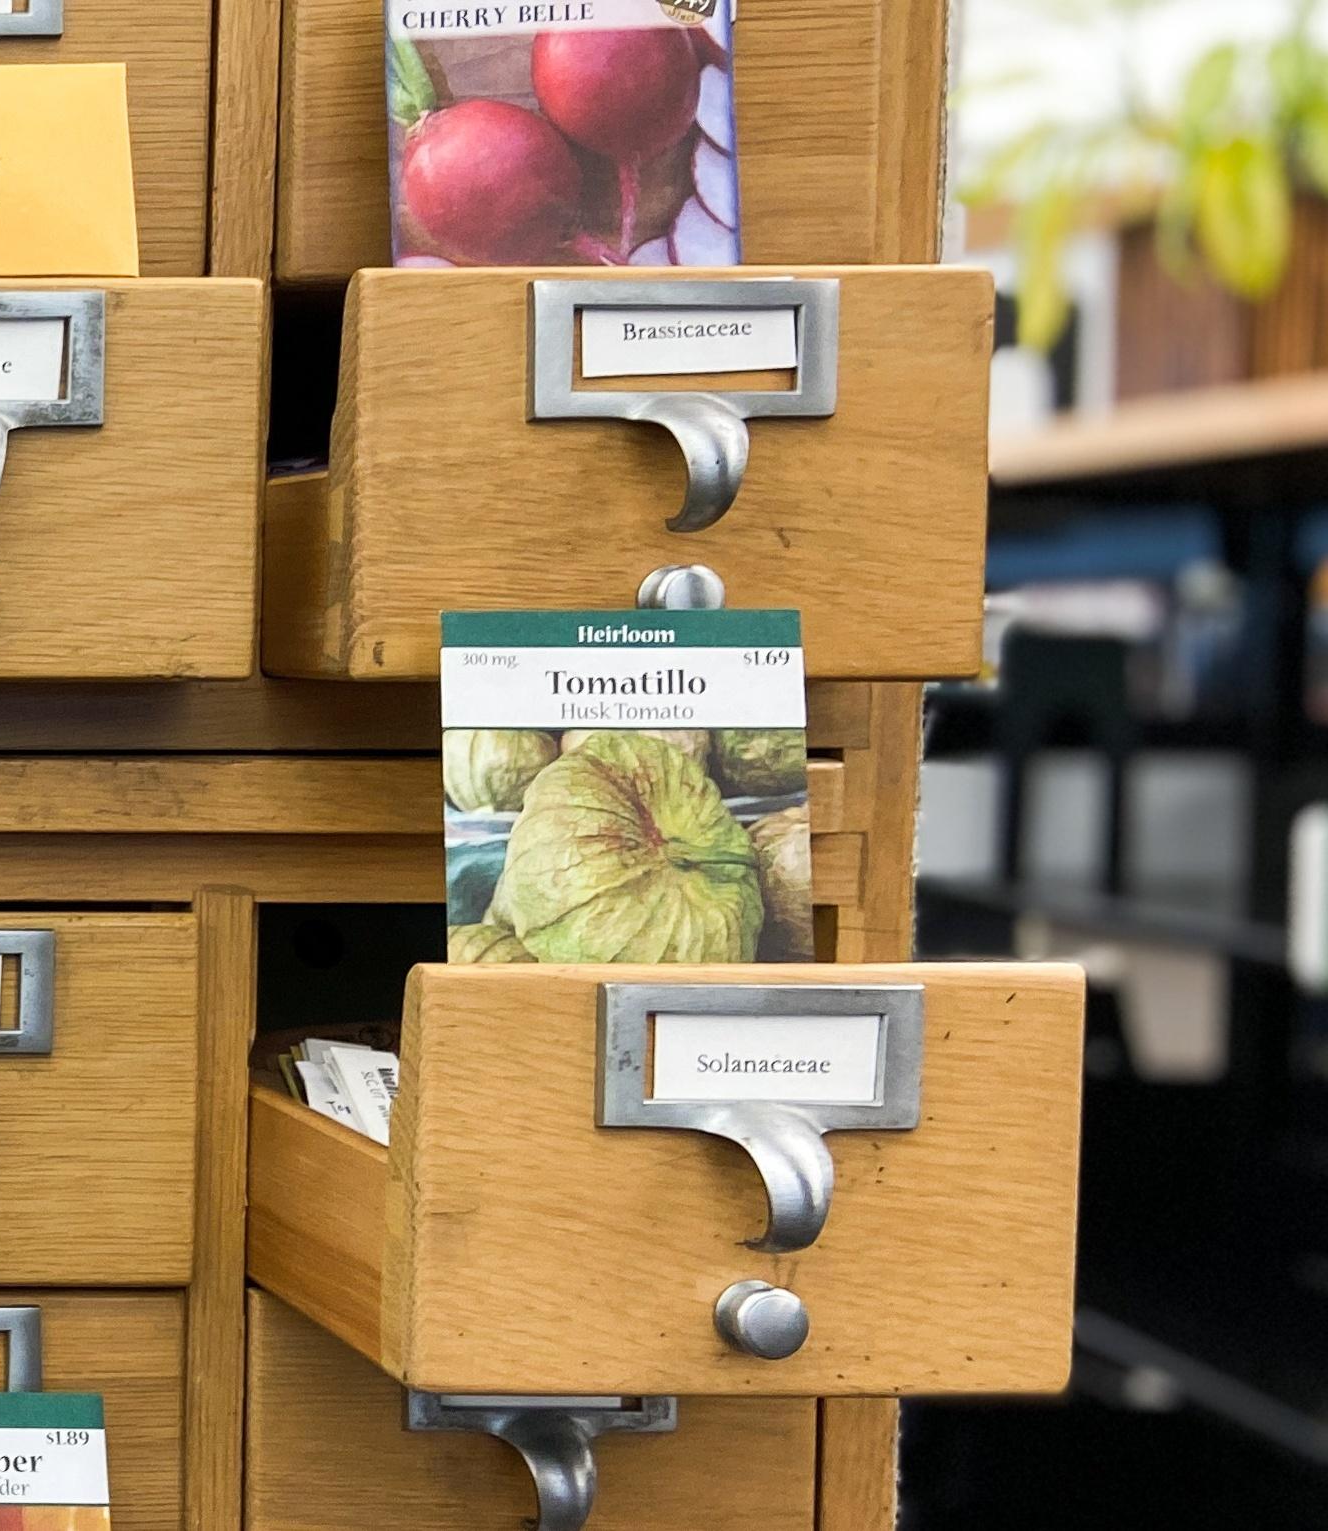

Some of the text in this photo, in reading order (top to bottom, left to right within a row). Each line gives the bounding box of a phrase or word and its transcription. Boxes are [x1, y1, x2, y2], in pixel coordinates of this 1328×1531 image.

[402, 2, 594, 29] CHERRY BELLE
[622, 320, 752, 342] Brassicaceae
[578, 625, 676, 644] Heirloom
[462, 653, 488, 667] 300
[744, 650, 790, 667] $1.69
[545, 669, 707, 696] Tomatillo
[561, 702, 694, 721] Husk Tomato
[697, 1052, 831, 1074] Solanacaeae
[46, 1430, 90, 1447] $1.89
